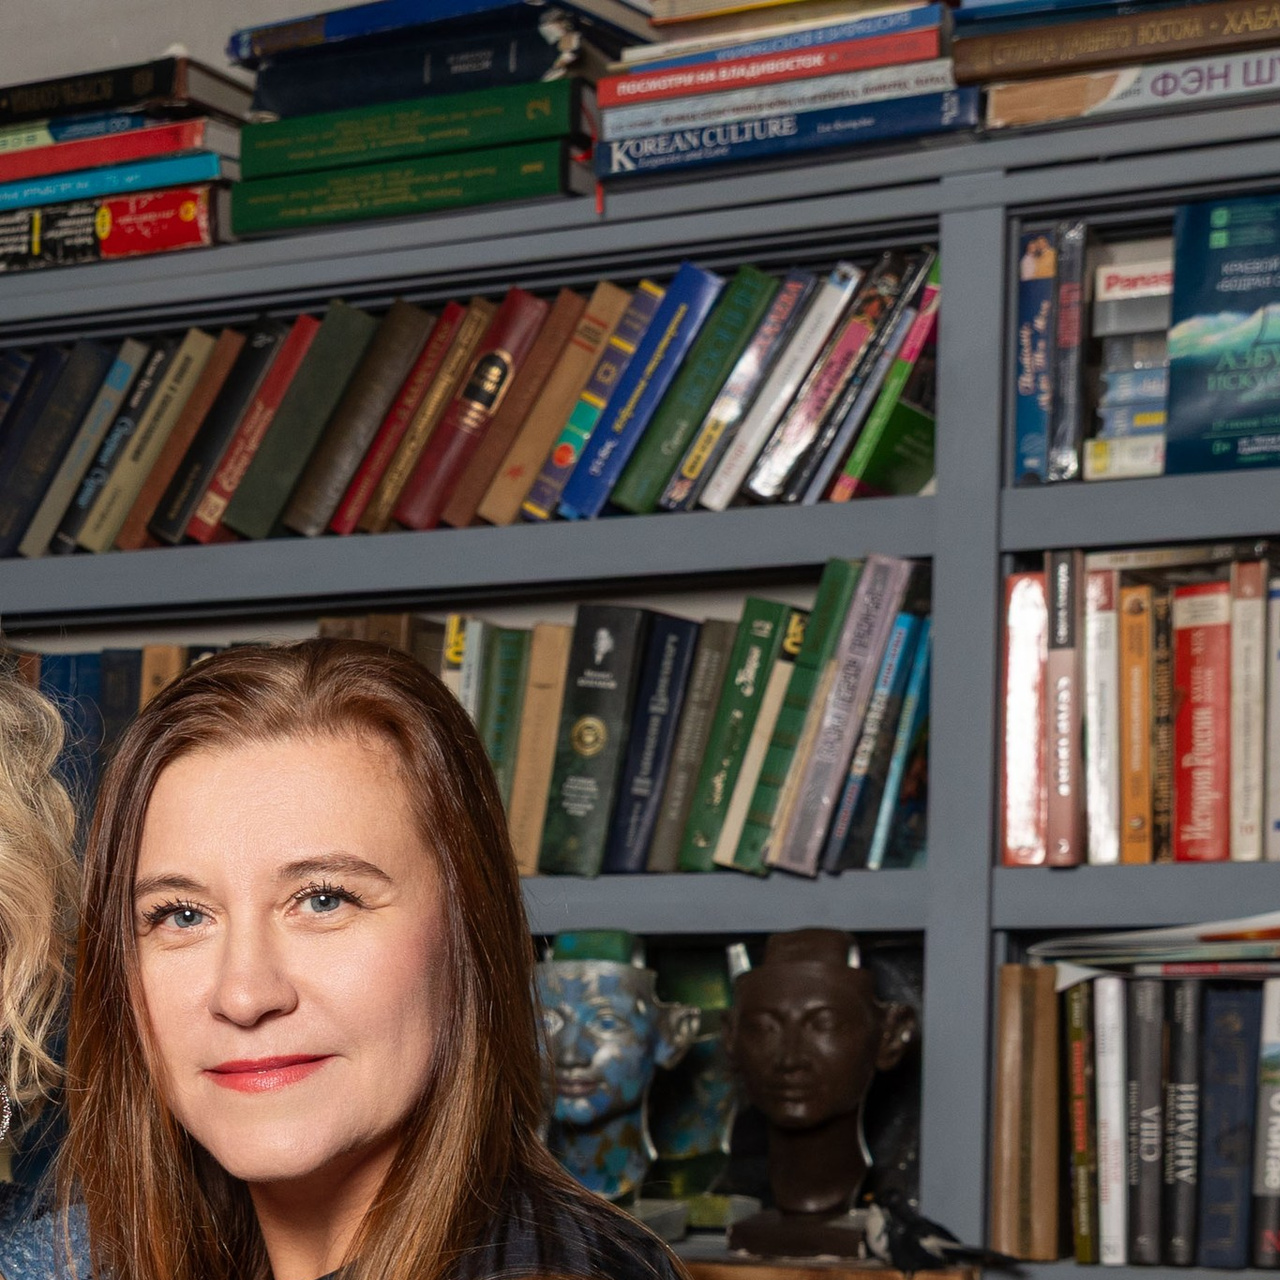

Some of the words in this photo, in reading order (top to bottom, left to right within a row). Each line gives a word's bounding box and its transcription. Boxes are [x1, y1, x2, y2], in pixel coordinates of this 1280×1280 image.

[718, 53, 824, 81] ВЛАДИВОСТОК
[1150, 64, 1232, 98] ФЭН
[609, 130, 701, 174] KOREAN
[701, 115, 798, 146] CULTURE
[1181, 768, 1220, 842] История
[1139, 1104, 1162, 1162] США
